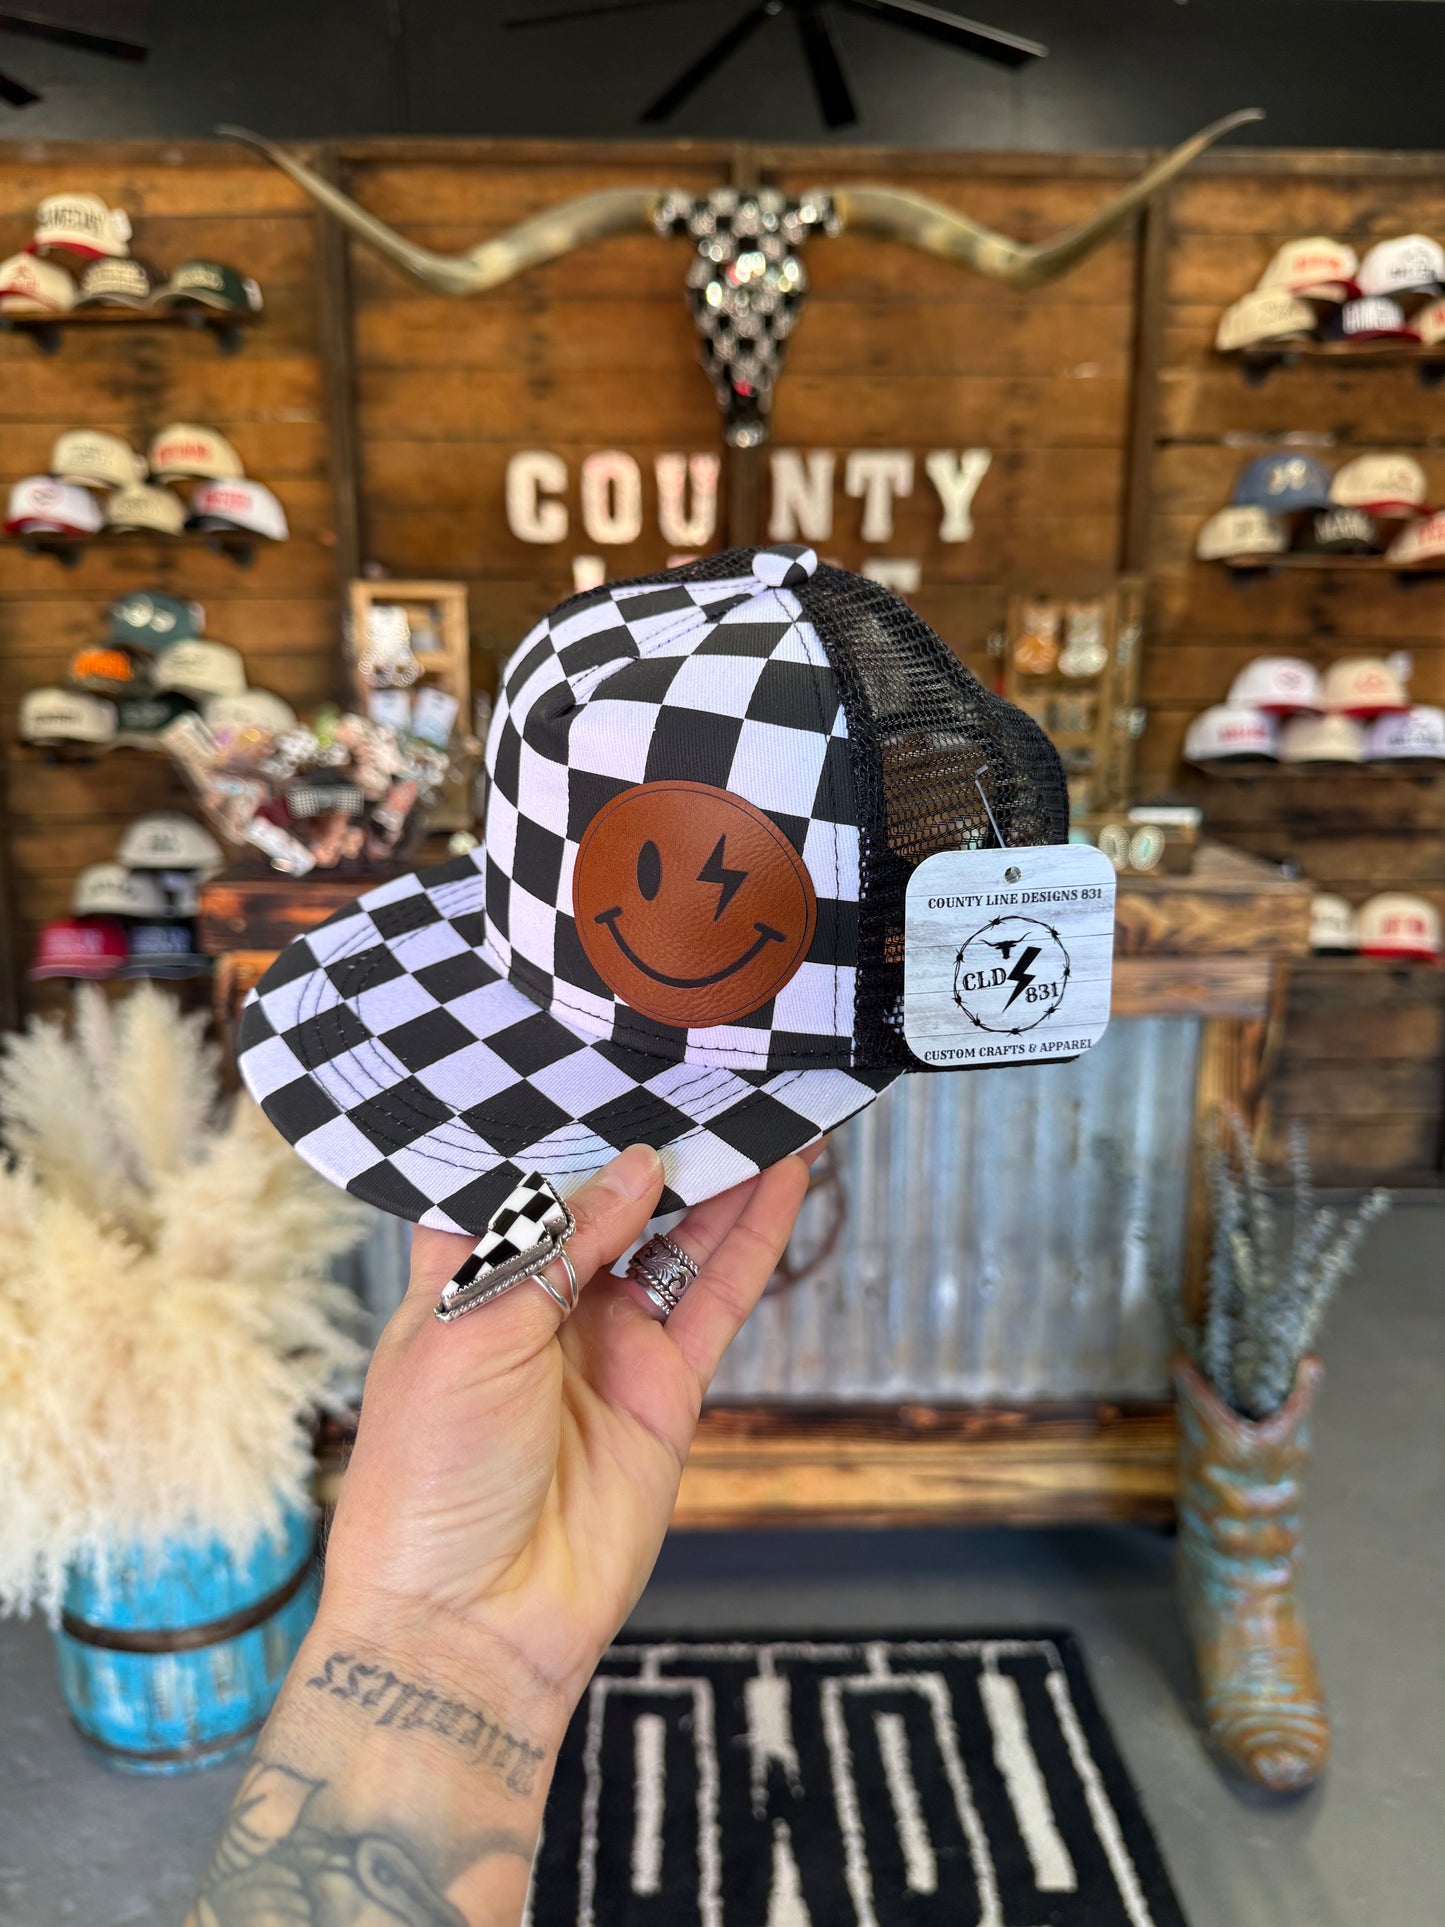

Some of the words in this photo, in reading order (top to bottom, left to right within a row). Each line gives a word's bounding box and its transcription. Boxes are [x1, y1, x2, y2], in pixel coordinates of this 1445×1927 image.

[505, 449, 992, 546] COUNTY
[928, 895, 983, 909] COUNTY
[986, 893, 1018, 906] LINE
[1021, 889, 1078, 904] DESIGNS
[1081, 888, 1102, 900] 831
[962, 967, 1007, 991] CLD
[1025, 981, 1059, 1003] 831
[924, 1047, 975, 1061] CUSTOM
[979, 1044, 1025, 1057] CRAFTS
[1029, 1043, 1037, 1053] &
[1039, 1039, 1093, 1053] APPAREL
